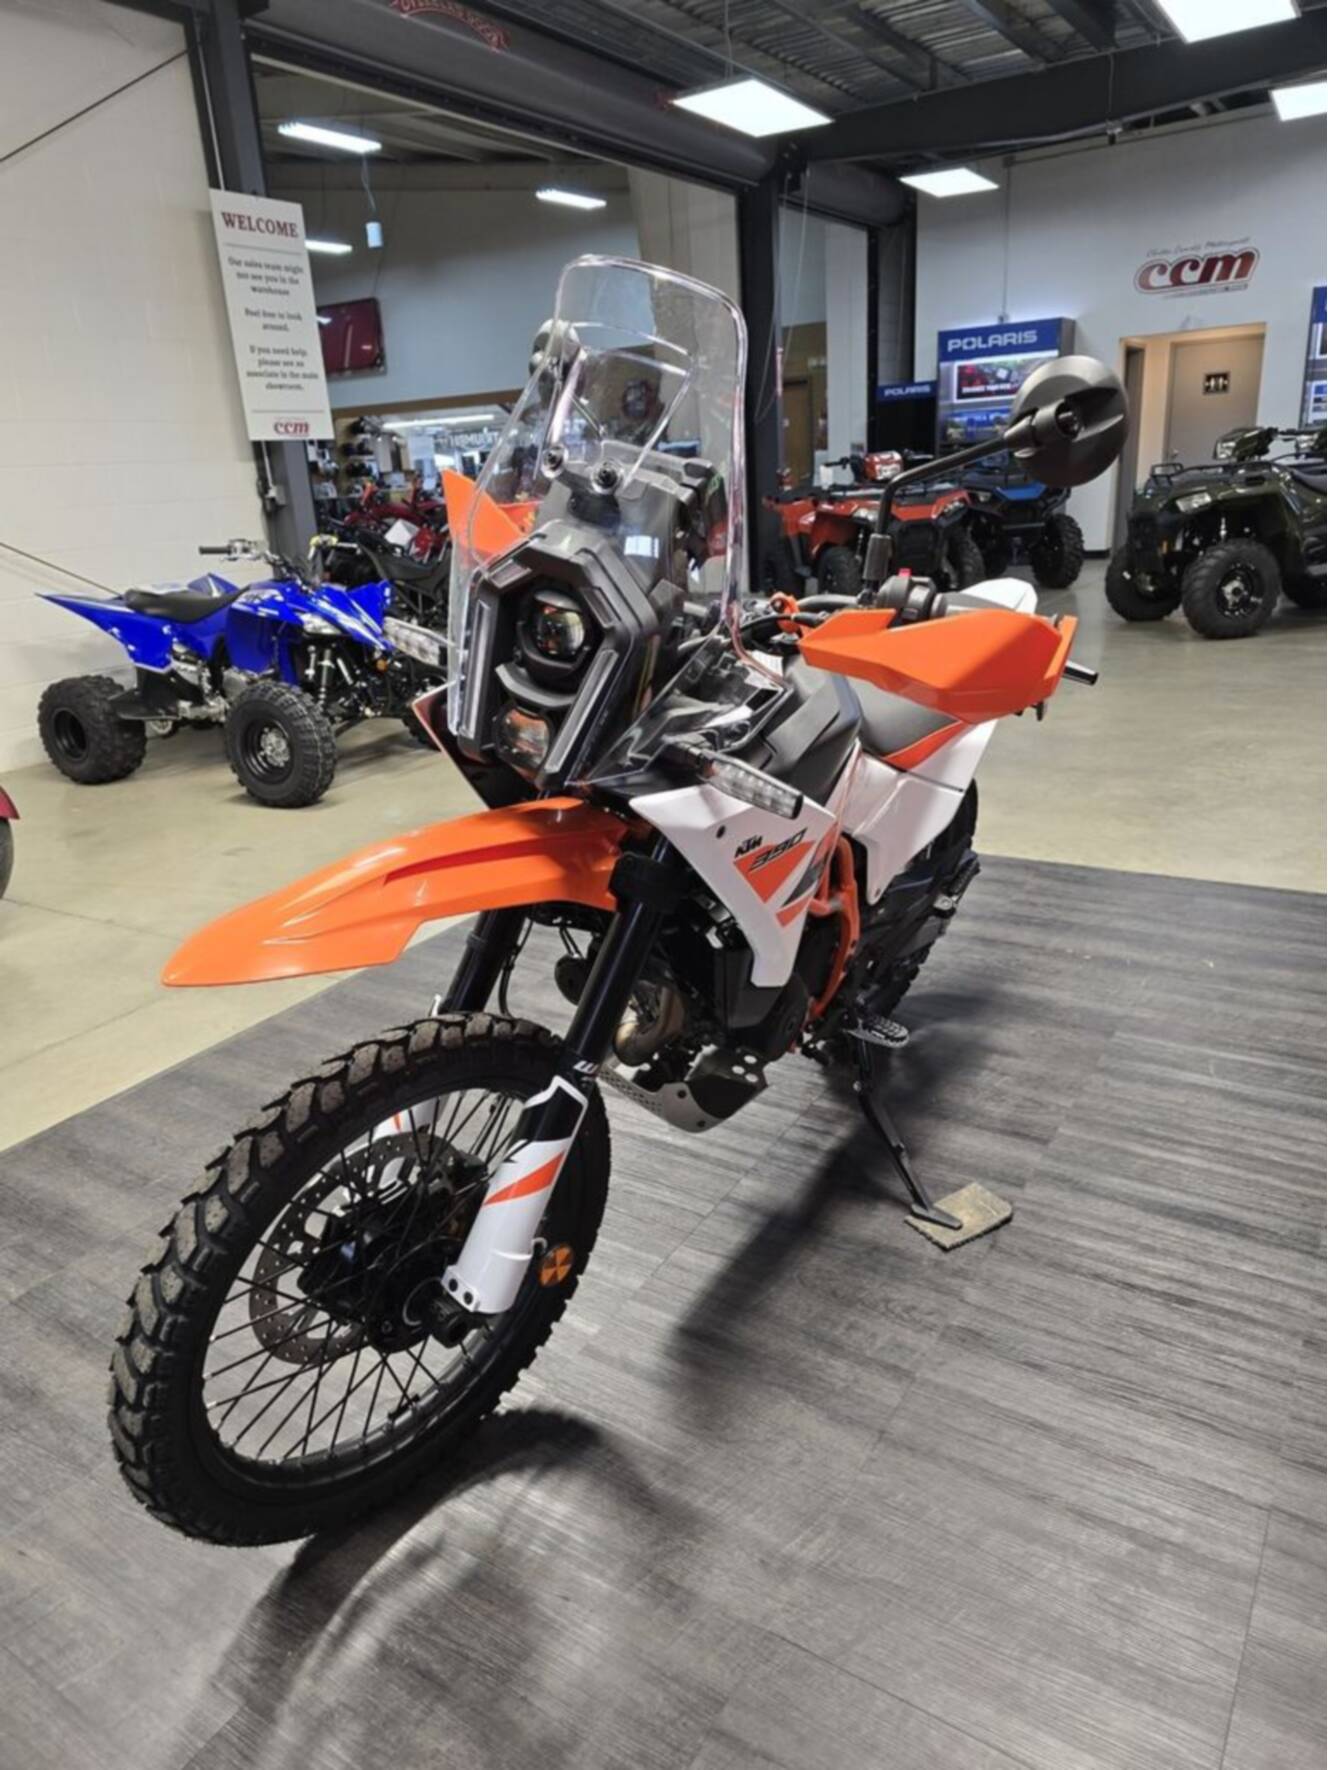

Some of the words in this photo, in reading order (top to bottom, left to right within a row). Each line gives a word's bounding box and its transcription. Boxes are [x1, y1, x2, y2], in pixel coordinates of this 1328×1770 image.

[221, 211, 299, 239] WELCOME
[264, 274, 278, 284] you
[1138, 250, 1256, 291] ccm
[257, 346, 271, 356] you
[947, 330, 1038, 352] POLARIS
[884, 384, 930, 397] POLARIS
[273, 421, 310, 435] ccm
[734, 835, 763, 859] KTM
[748, 826, 809, 872] 390
